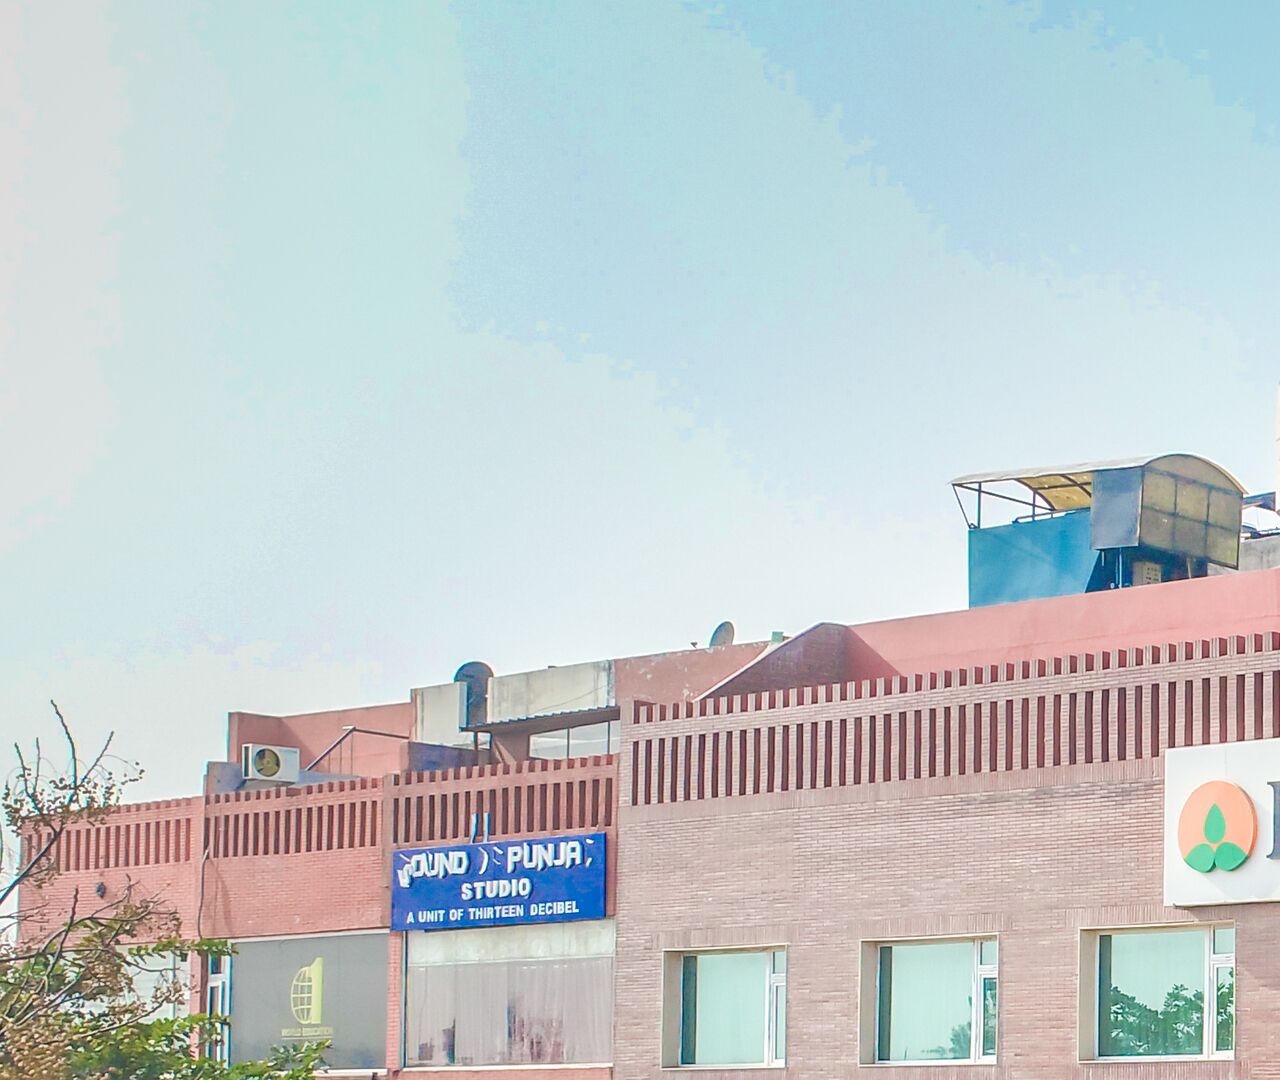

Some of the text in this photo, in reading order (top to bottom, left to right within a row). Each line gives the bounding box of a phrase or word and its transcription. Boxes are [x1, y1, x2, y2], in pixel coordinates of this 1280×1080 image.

[461, 877, 532, 900] STUDIO
[406, 900, 579, 924] A UNIT OF THIRTEEN DECIBEL
